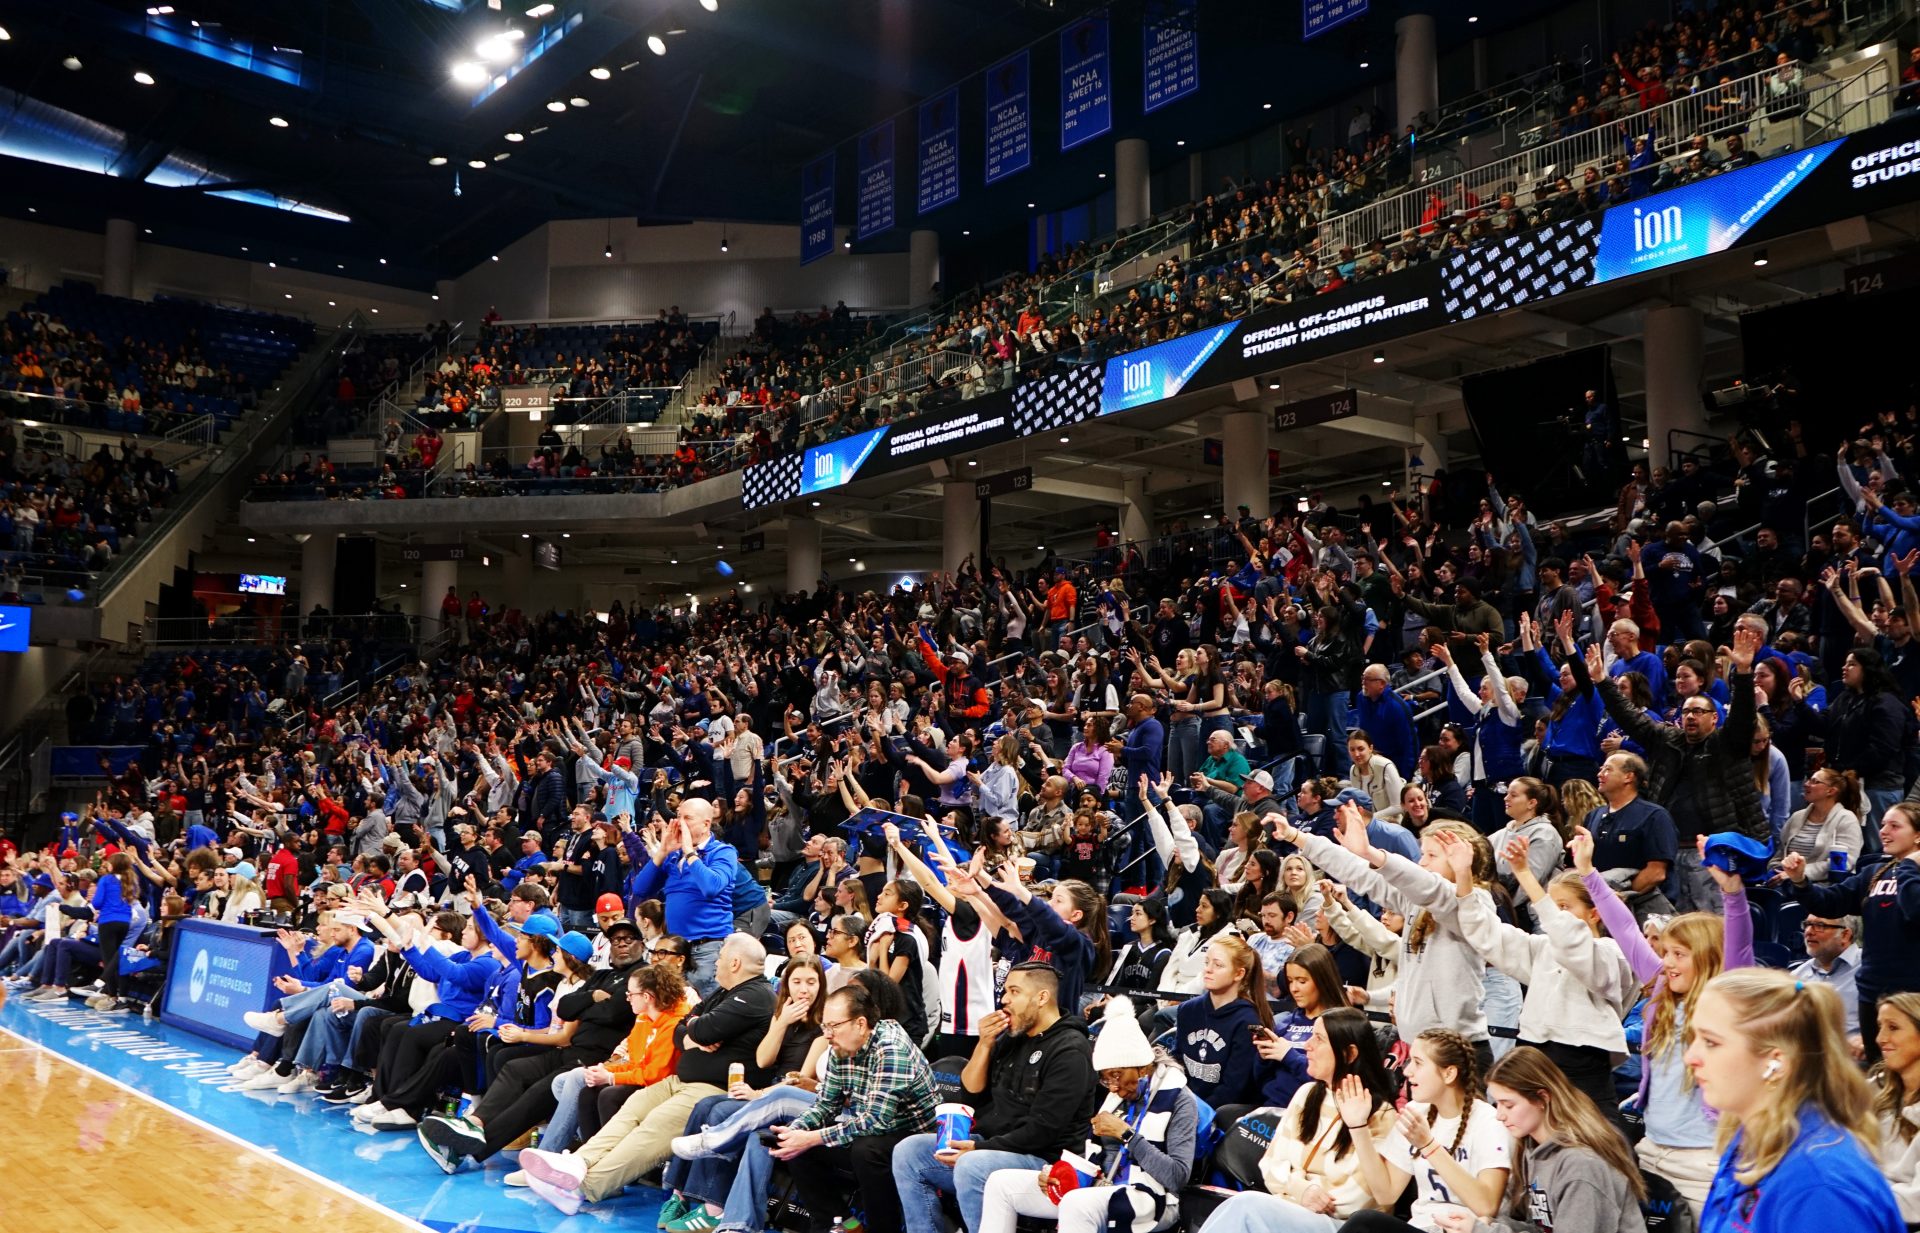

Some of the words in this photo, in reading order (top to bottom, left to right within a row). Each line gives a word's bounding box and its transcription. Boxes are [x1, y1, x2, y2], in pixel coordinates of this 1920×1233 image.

[1148, 40, 1192, 66] APPEARANCES
[1149, 30, 1192, 56] TOURNAMENT
[1072, 68, 1098, 89] NCAA
[1069, 84, 1092, 102] SWEET
[1095, 80, 1102, 89] 16
[991, 112, 1025, 135] TOURNAMENT
[998, 104, 1018, 122] NCAA
[990, 121, 1026, 143] APPEARANCES
[1520, 130, 1543, 148] 225
[929, 140, 947, 156] NCAA
[1420, 165, 1442, 182] 224
[1740, 171, 1796, 223] CHARGED
[1797, 153, 1814, 170] UP
[809, 229, 826, 246] 1988
[1634, 206, 1682, 251] ion
[1848, 272, 1885, 296] 124
[1242, 334, 1299, 358] STUDENT
[1300, 316, 1361, 342] HOUSING
[1365, 297, 1429, 325] PARTNER
[1243, 321, 1296, 345] OFFICIAL
[1299, 295, 1385, 329] OFF-CAMPUS
[1124, 360, 1150, 392] ion
[506, 398, 522, 406] 220
[528, 398, 542, 406] 221
[1277, 412, 1296, 427] 123
[1330, 399, 1351, 415] 124
[891, 430, 924, 445] OFFICIAL
[926, 414, 978, 435] OFF-CAMPUS
[891, 439, 925, 455] STUDENT
[927, 429, 964, 445] HOUSING
[966, 417, 1004, 435] PARTNER
[815, 452, 833, 478] ion
[977, 484, 990, 496] 122
[1013, 475, 1026, 487] 123
[403, 550, 420, 559] 120
[449, 549, 464, 559] 121
[212, 956, 239, 971] MIDWEST
[209, 974, 252, 995] ORTHOPAEDICS
[206, 992, 213, 1002] AT
[1188, 1028, 1226, 1051] UCONN
